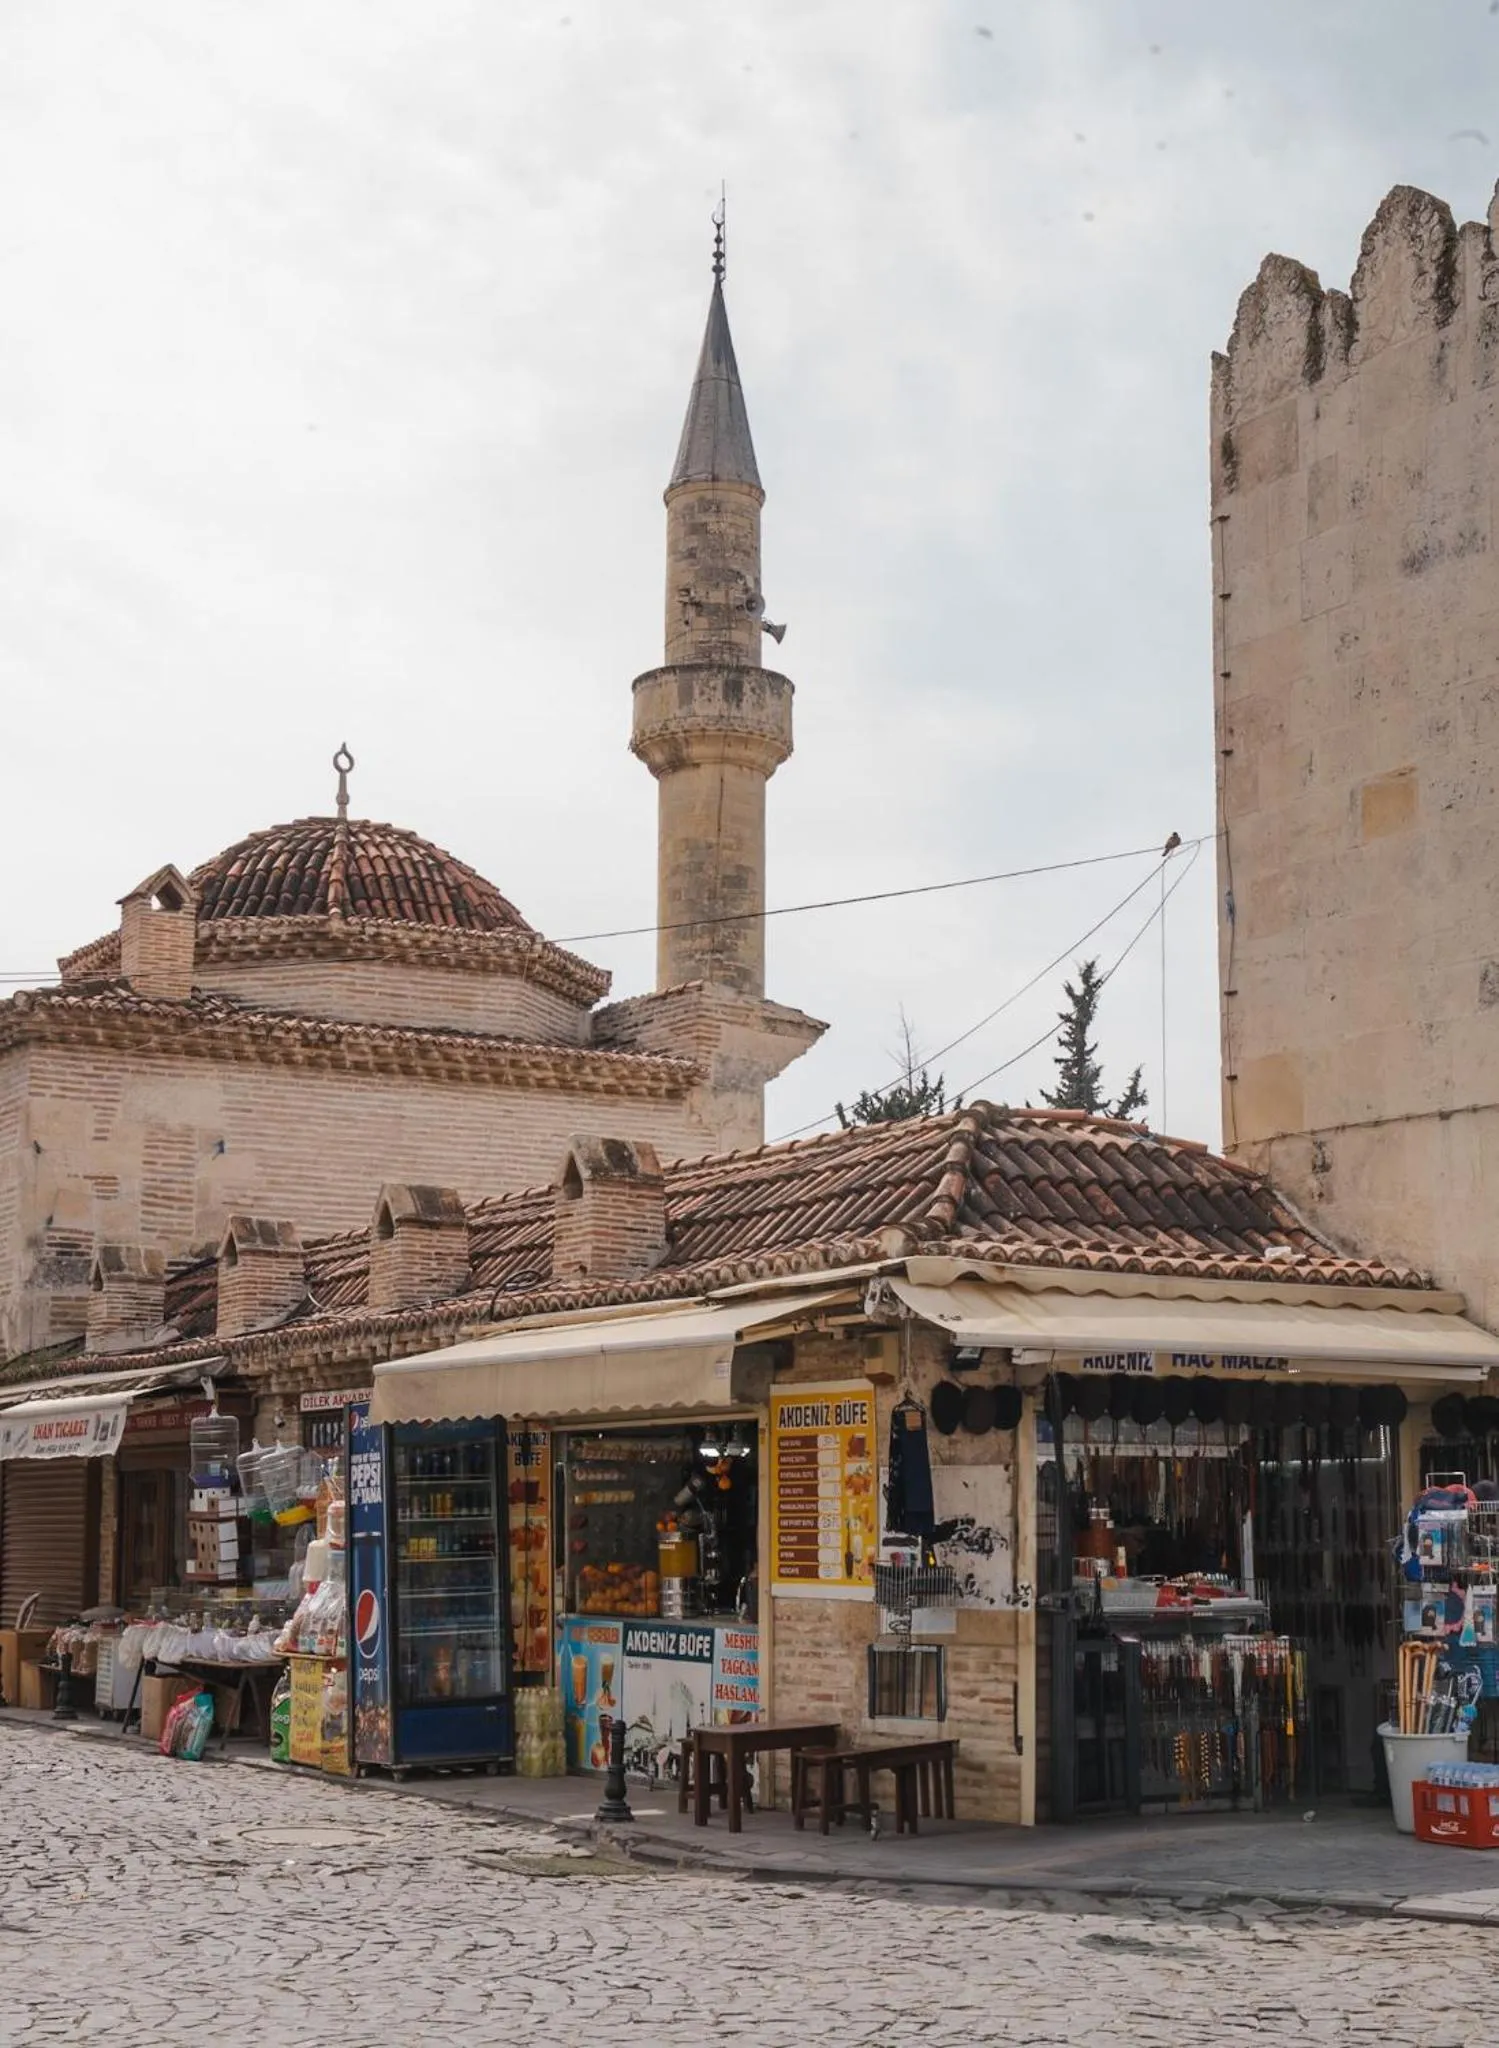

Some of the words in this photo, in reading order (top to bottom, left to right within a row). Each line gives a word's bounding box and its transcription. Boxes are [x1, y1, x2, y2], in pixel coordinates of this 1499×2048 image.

[778, 1401, 831, 1429] AKDENİZ
[834, 1399, 868, 1426] BÜFE
[359, 1664, 380, 1685] pepsi
